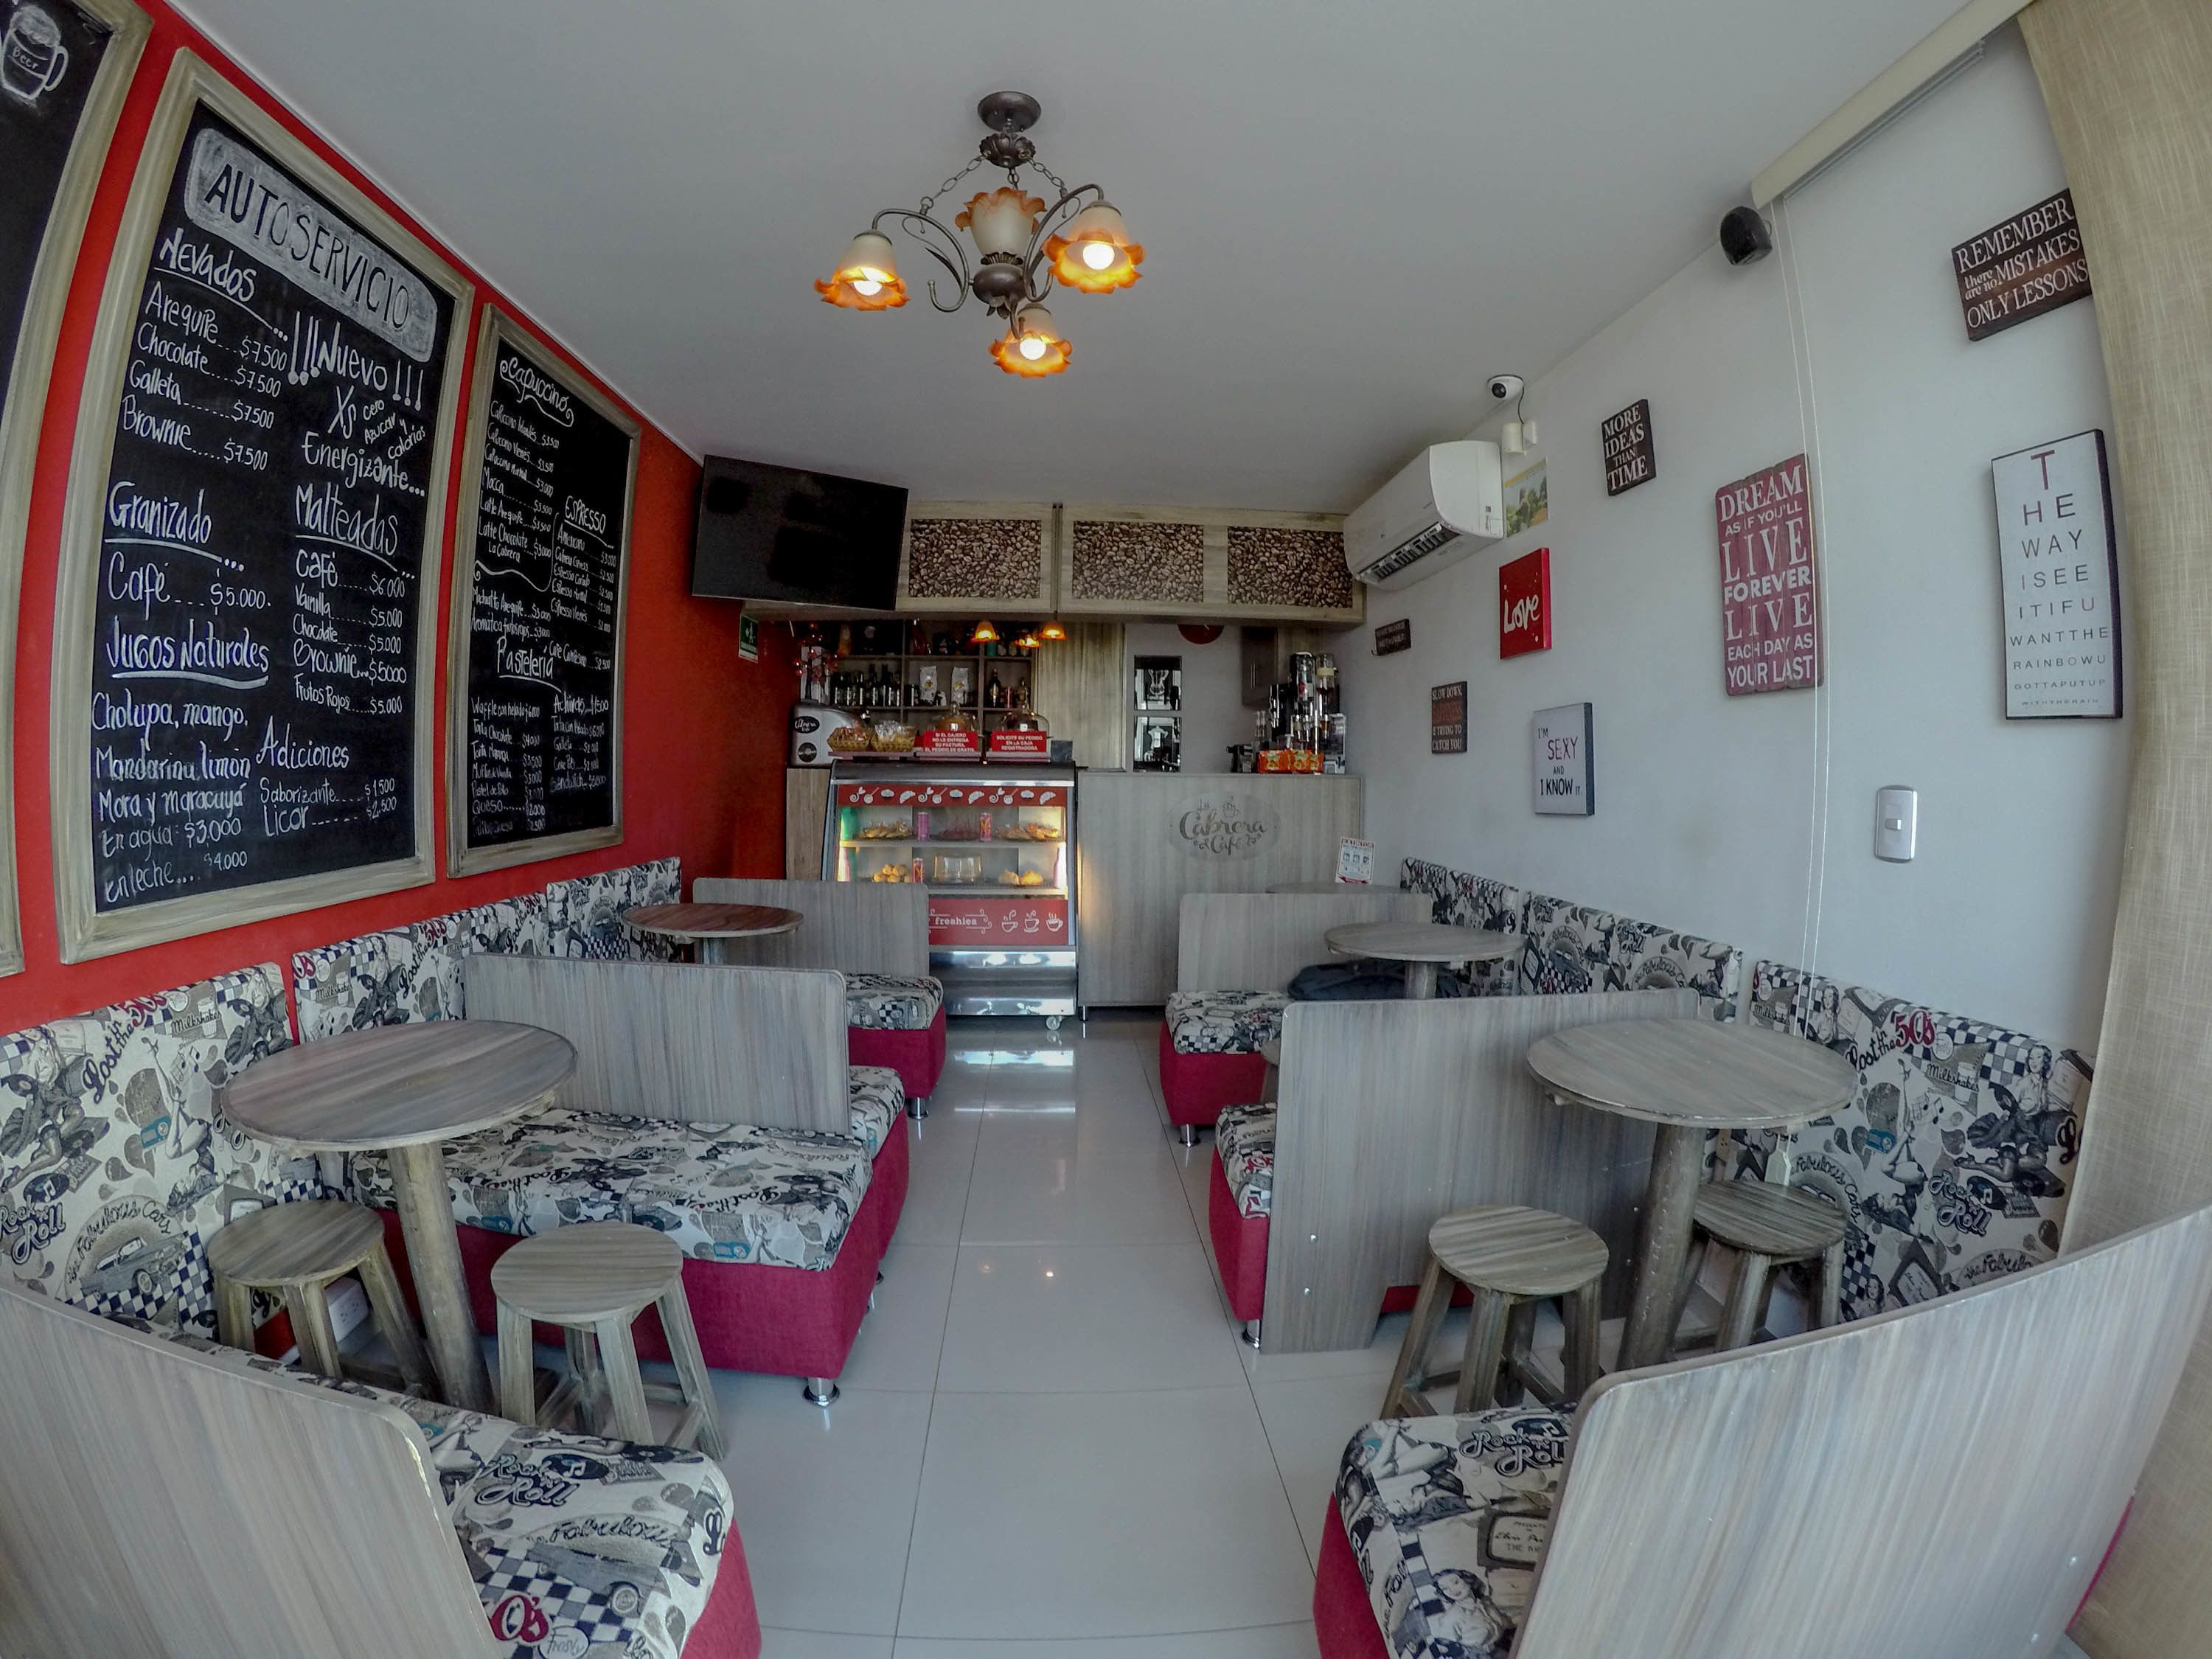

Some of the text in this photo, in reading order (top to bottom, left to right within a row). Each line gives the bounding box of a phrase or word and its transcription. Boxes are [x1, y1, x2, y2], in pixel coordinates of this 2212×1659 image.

[204, 164, 411, 329] AUTOSERVICIO
[1956, 198, 2074, 274] REMEMBER
[1995, 229, 2080, 286] MISTAKES
[1964, 270, 1993, 290] there
[1965, 279, 1998, 301] are no
[1967, 258, 2088, 329] ONLY LESSONS
[138, 322, 210, 375] Chocolate
[130, 360, 181, 405] Galleta
[1604, 403, 1641, 439] MORE
[1604, 423, 1644, 459] IDEAS
[1613, 446, 1636, 467] THAN
[1607, 456, 1648, 491] TIME
[2031, 450, 2055, 490] T
[1719, 464, 1804, 522] DREAM
[109, 481, 212, 544] Granizado
[296, 481, 398, 556] Malteadas
[565, 495, 606, 535] ESPRESSO
[1725, 500, 1802, 537] AS IF YOU'LL
[1722, 516, 1808, 584] LIVE
[2022, 529, 2081, 559] WAY
[1724, 565, 1811, 605] FOREVER
[1504, 594, 1540, 633] Love
[1726, 593, 1812, 641] LIVE
[181, 619, 269, 672] Naturales
[1728, 633, 1814, 662] EACH DAY AS
[1728, 654, 1813, 688] YOUR LAST
[471, 696, 497, 721] Waffle
[256, 715, 349, 770] Adiciones
[1548, 737, 1578, 761] SEXY
[1546, 778, 1573, 796] KNOW
[1553, 765, 1565, 775] AND
[98, 789, 142, 824] Mora
[264, 804, 309, 837] Licor
[1180, 809, 1268, 840] Cabrera
[171, 1010, 221, 1033] Milkshakes
[1927, 1062, 1980, 1093] Milkshakes
[11, 1201, 66, 1266] Roll
[476, 1473, 580, 1506] Roll
